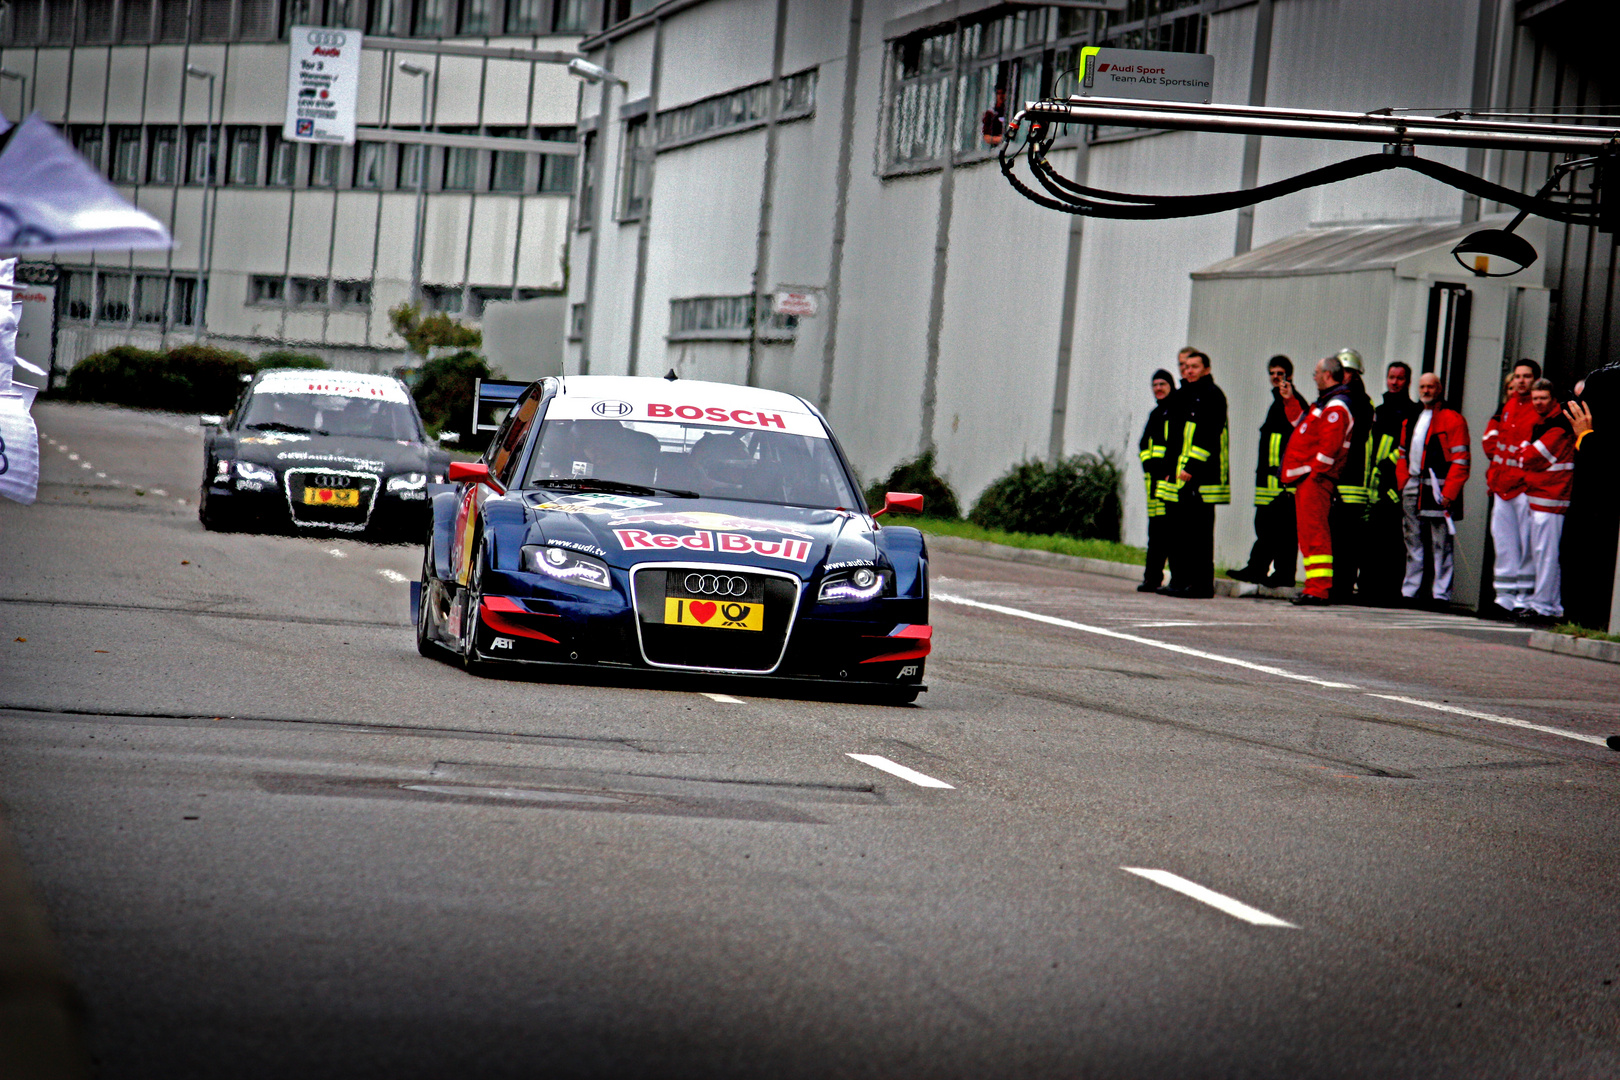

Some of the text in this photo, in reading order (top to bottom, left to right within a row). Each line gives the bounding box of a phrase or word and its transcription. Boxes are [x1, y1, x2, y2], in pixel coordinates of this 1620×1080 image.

[313, 46, 340, 57] Audi
[1110, 64, 1166, 75] Audi Sport
[1110, 74, 1210, 88] Team Abt Sportsline
[647, 403, 786, 429] BOSCH
[547, 538, 607, 557] www.audi.tv
[616, 529, 809, 560] Red Bull
[823, 558, 875, 571] www.audi.tv
[490, 637, 516, 650] ABT
[896, 665, 919, 679] ABT
